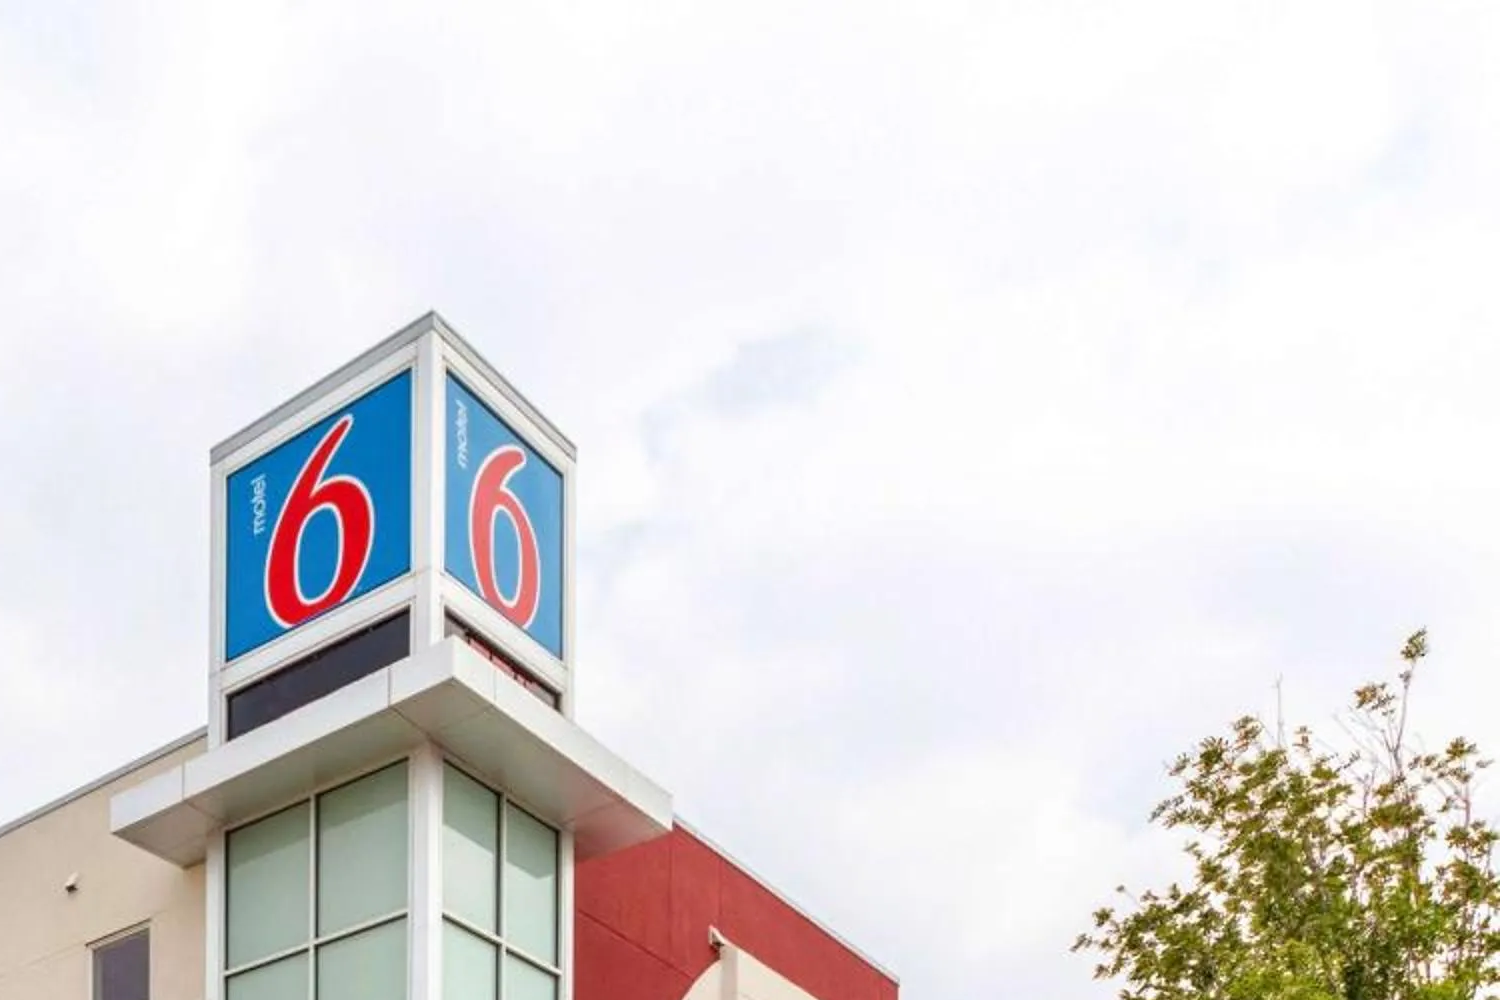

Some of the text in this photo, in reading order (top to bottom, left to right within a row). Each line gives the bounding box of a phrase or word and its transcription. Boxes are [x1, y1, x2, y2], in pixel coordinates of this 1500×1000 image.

[455, 399, 469, 469] motel
[250, 473, 266, 535] motel
[265, 414, 374, 628] 6
[468, 445, 541, 628] 6
